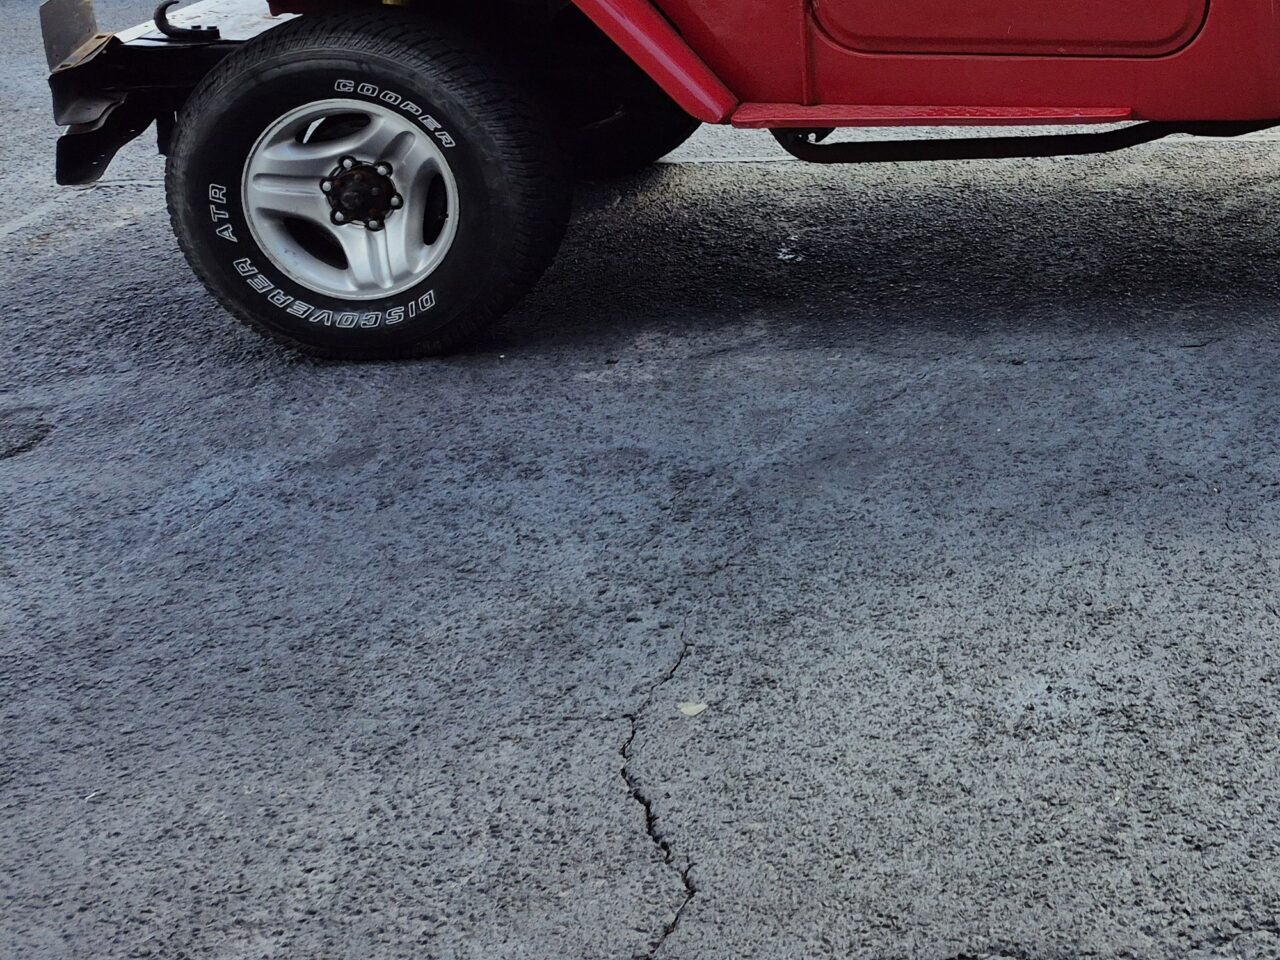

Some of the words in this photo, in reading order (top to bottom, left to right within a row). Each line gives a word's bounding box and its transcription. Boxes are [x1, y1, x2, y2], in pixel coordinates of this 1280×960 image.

[334, 78, 456, 148] COOPER
[208, 183, 238, 243] ATR
[233, 257, 436, 329] DISCOVERER
